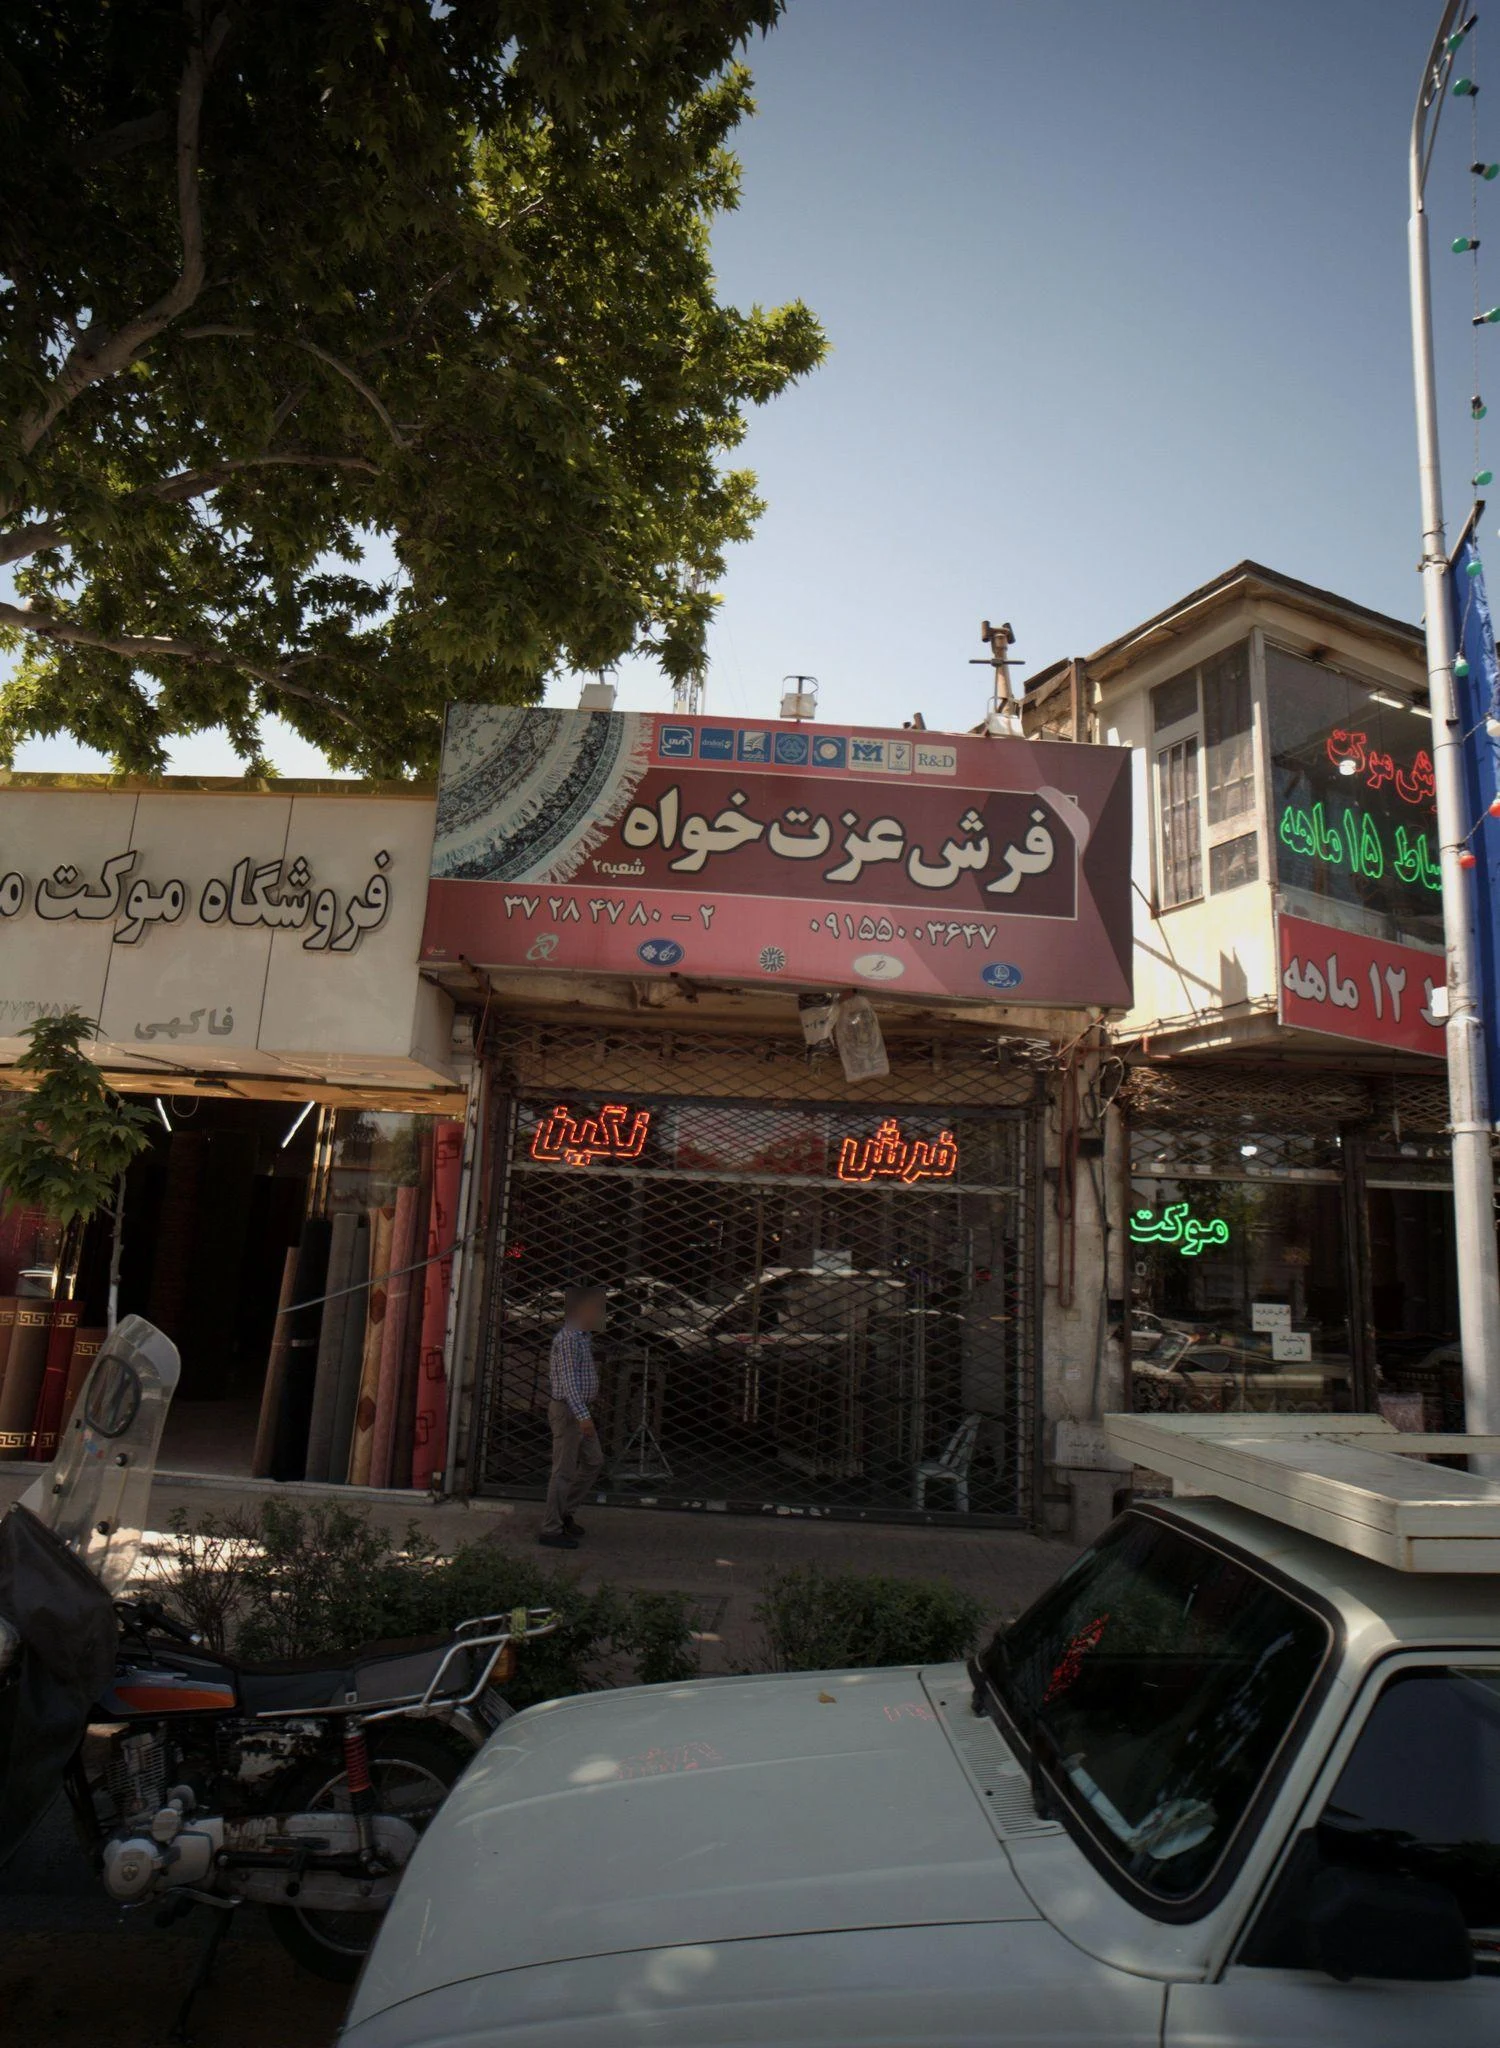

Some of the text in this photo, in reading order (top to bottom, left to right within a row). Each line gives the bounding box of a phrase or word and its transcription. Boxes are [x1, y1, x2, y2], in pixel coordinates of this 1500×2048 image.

[906, 807, 1056, 895] فرش
[1280, 802, 1342, 864] ماهه
[1393, 824, 1442, 891] ساط
[35, 849, 186, 945] موکت
[199, 849, 393, 951] فروشگاه
[1283, 954, 1360, 1010] ماهه
[1368, 960, 1407, 1024] ۱۲
[838, 1117, 958, 1184] فرش
[1129, 1202, 1230, 1256] موکت
